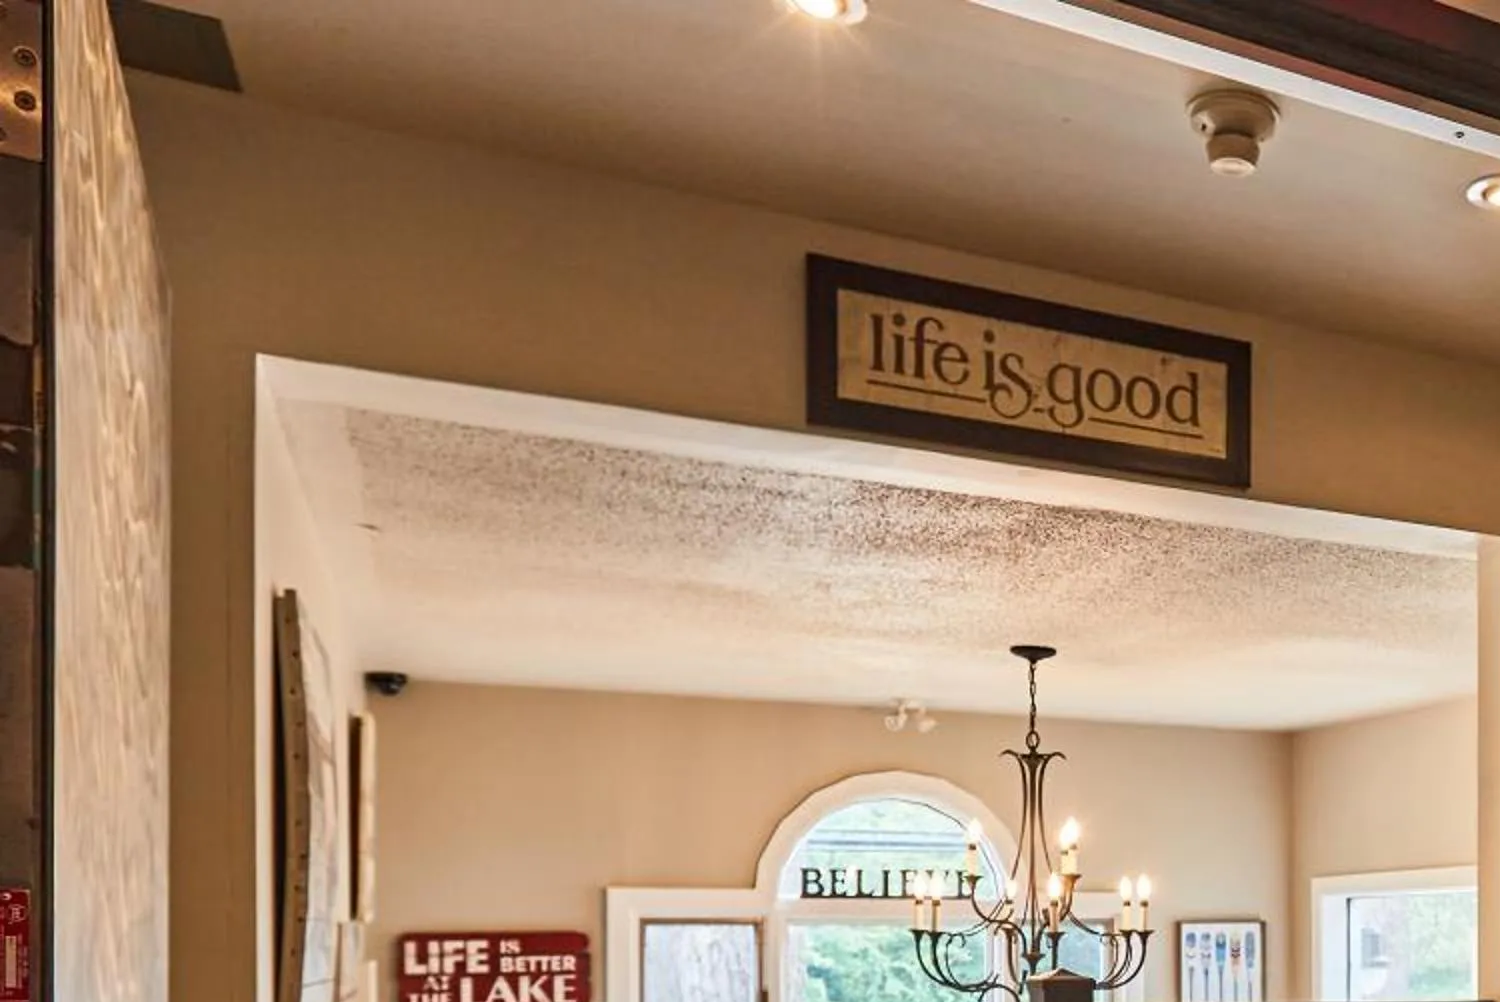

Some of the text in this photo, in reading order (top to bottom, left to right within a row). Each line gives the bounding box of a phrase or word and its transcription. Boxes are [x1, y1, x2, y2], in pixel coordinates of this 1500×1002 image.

[868, 313, 1201, 428] life is good
[800, 867, 973, 898] BELIEE
[404, 940, 490, 975] LIFE
[500, 939, 521, 954] IS
[500, 955, 576, 973] BETTER
[423, 976, 450, 991] AT
